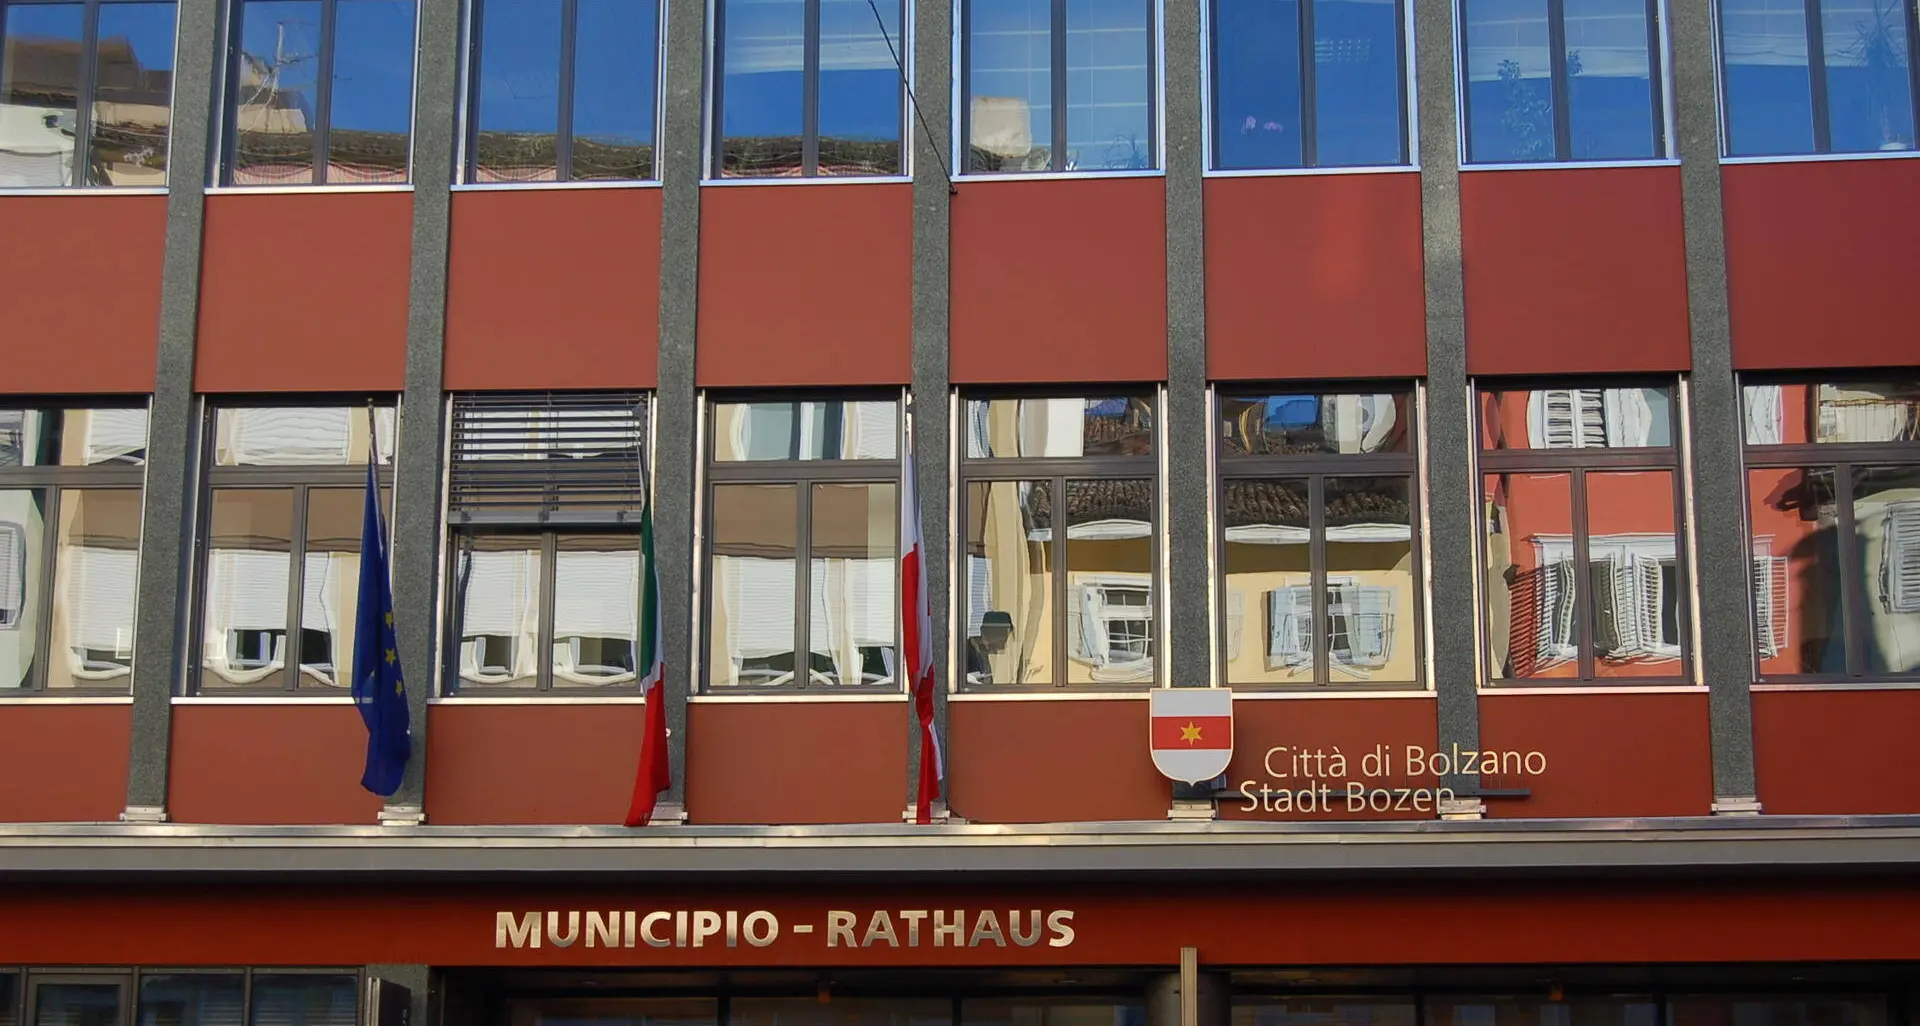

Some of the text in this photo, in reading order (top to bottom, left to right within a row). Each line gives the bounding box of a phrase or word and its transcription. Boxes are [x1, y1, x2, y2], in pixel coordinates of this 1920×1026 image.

[1264, 743, 1547, 778] Città di Bolzano
[1240, 780, 1454, 814] Stadt Bozen
[495, 911, 779, 948] MUNICIPIO
[827, 910, 1075, 948] RATHAUS
